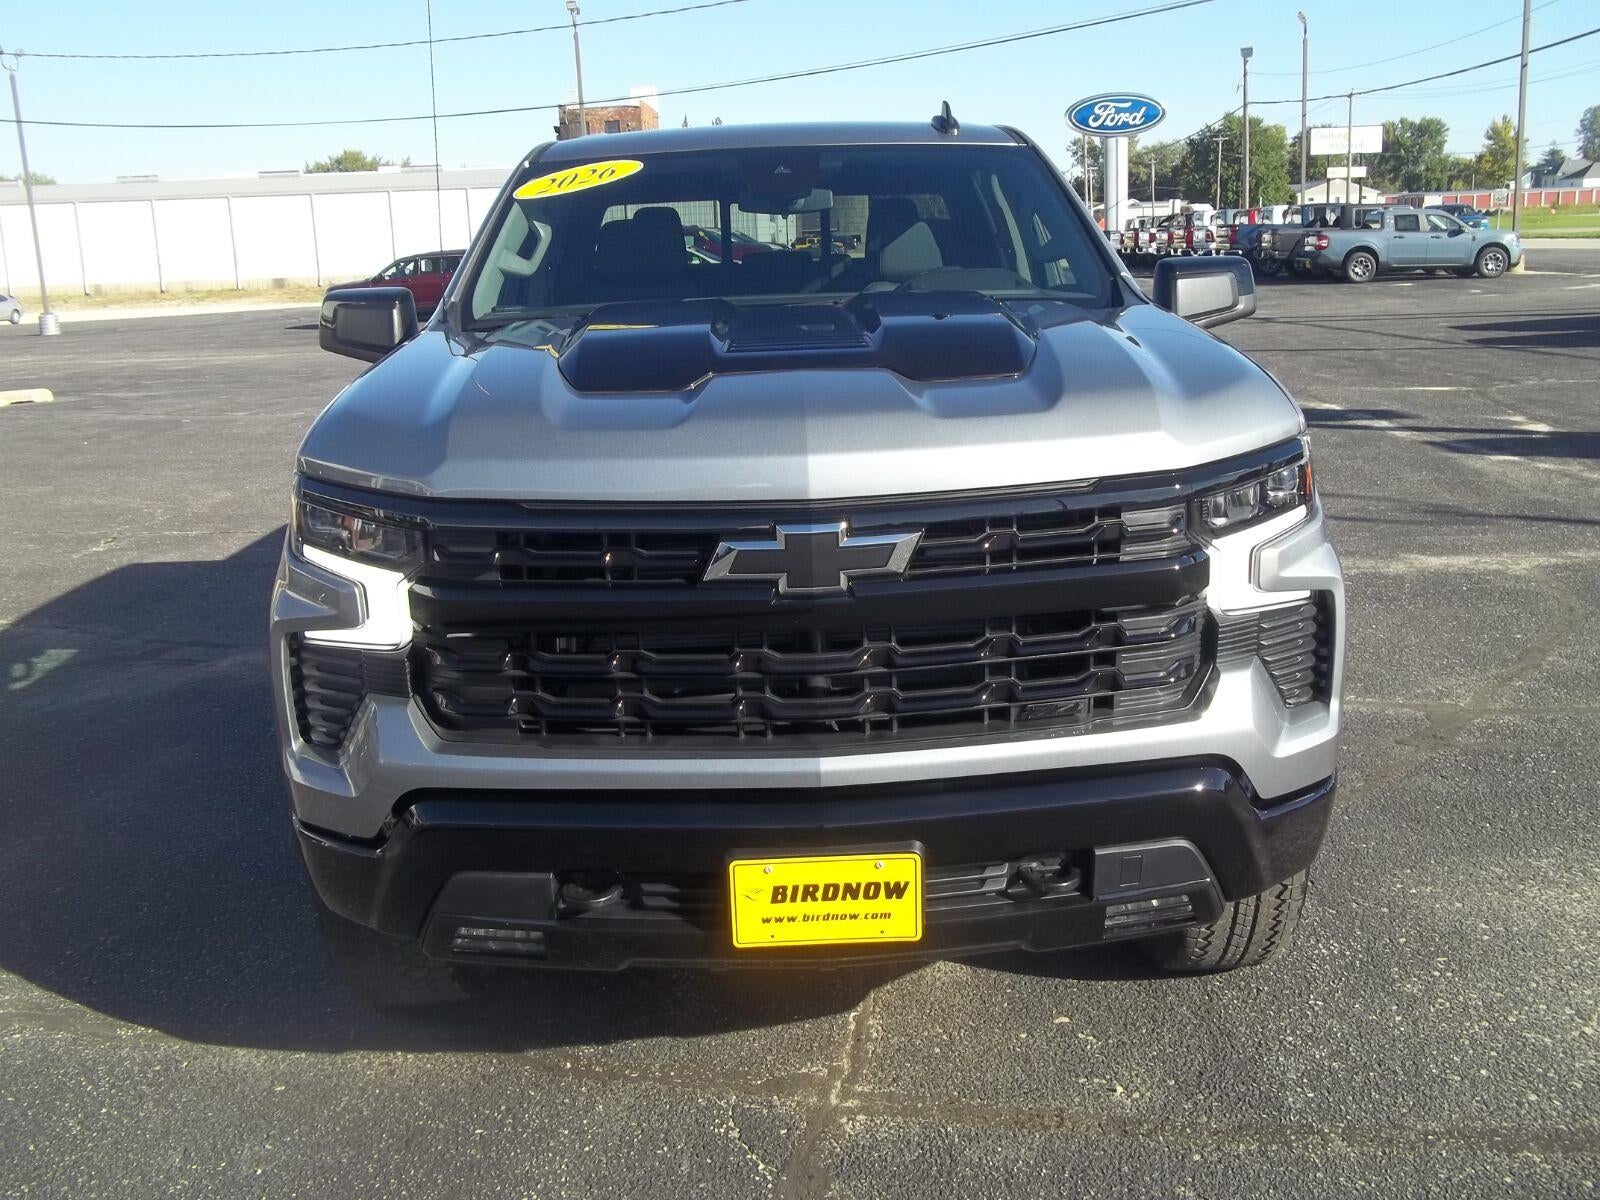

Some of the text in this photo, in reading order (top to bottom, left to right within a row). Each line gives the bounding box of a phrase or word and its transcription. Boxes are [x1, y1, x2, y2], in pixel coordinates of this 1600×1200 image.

[1088, 101, 1147, 128] Ford
[536, 166, 616, 195] 2026
[770, 880, 910, 904] BIRDNOW
[761, 912, 892, 924] www.birdnow.com
